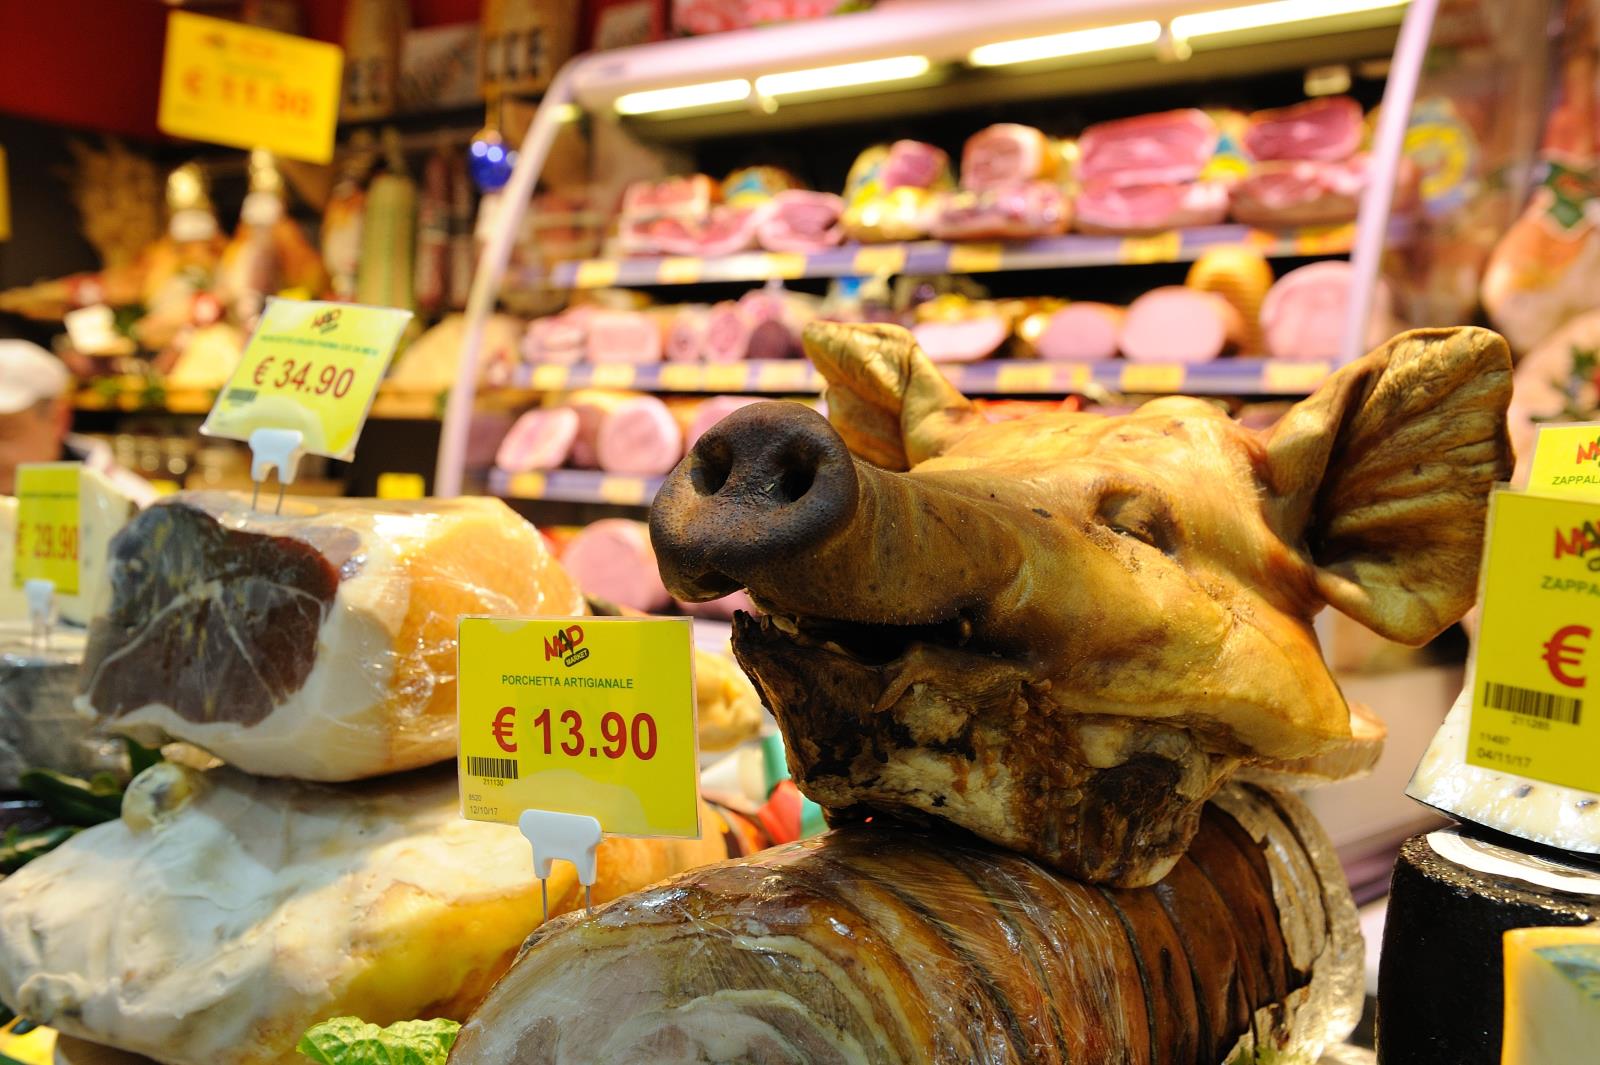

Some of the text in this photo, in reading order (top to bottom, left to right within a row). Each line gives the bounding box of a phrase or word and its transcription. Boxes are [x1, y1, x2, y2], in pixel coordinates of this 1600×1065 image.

[253, 356, 355, 399] € 34.90
[1551, 475, 1600, 485] ZAPPAL
[1541, 624, 1593, 688] €
[502, 675, 634, 689] PORCHETTA ARTIGIANALE
[491, 706, 658, 761] € 13.90
[483, 778, 504, 787] 211130
[469, 805, 498, 816] 12/10/17
